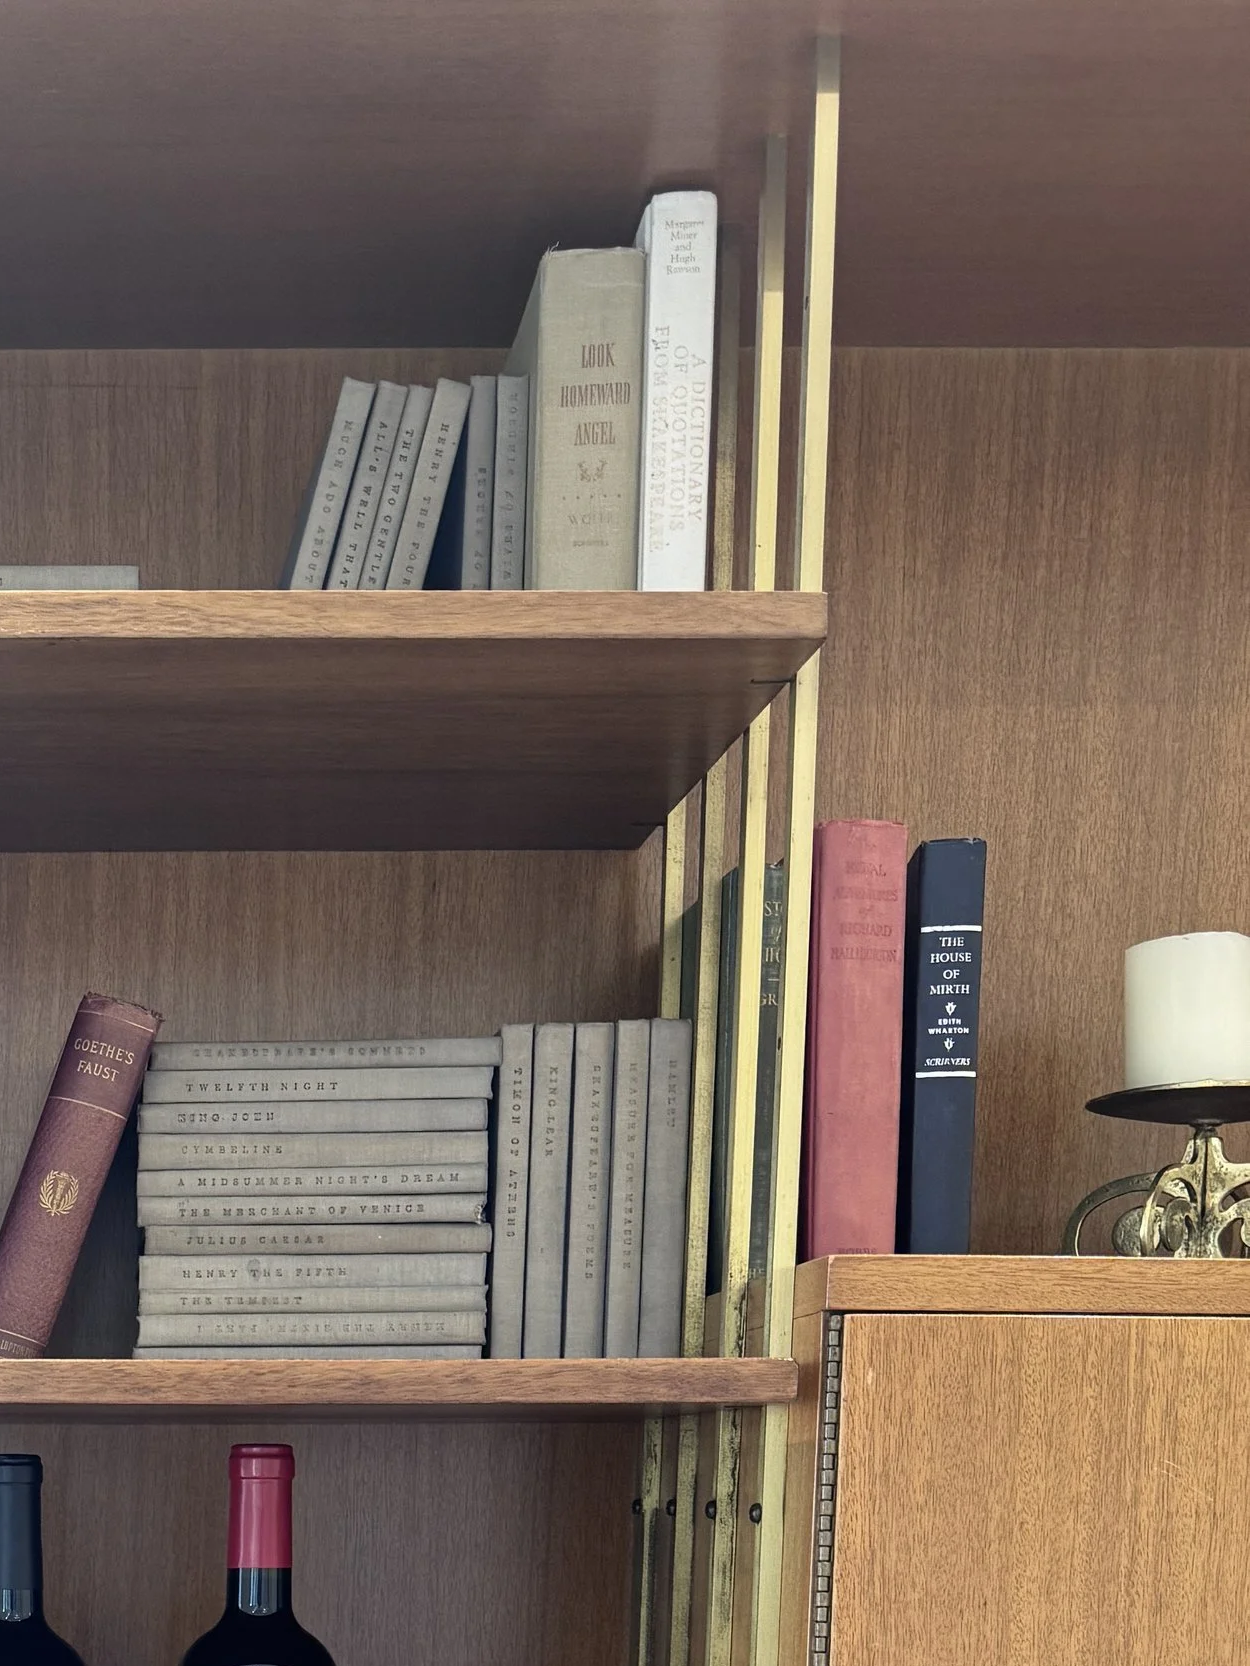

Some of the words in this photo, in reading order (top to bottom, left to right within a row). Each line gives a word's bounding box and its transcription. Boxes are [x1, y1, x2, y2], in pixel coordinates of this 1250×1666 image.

[665, 219, 705, 231] Margaret
[670, 230, 698, 241] Miner
[670, 252, 696, 265] Hugh
[674, 240, 692, 251] and
[666, 264, 701, 275] Rawson
[580, 342, 616, 369] LOOK
[651, 325, 671, 388] FROM
[673, 344, 690, 375] OF
[691, 352, 708, 369] A
[559, 381, 632, 409] HOMEWARD
[333, 419, 355, 469] MUCH
[368, 421, 389, 473] ALL'S
[398, 428, 415, 463] THE
[573, 420, 617, 447] ANGEL
[428, 422, 451, 484] HENRY
[668, 384, 689, 533] QUOTATIONS
[687, 380, 707, 522] DICTIONARY
[322, 479, 340, 515] ADO
[387, 471, 405, 507] TWO
[353, 485, 373, 531] WELL
[415, 495, 433, 530] THE
[304, 525, 327, 585] ABOUT
[368, 514, 393, 585] GENTLE
[339, 543, 359, 589] THAT
[401, 541, 421, 587] FOUR
[939, 936, 965, 948] THE
[930, 952, 972, 964] HOUSE
[942, 969, 961, 980] OF
[930, 984, 971, 996] MIRTH
[928, 1027, 970, 1036] WHARTON
[937, 1018, 962, 1026] EDITH
[73, 1037, 136, 1066] GOETHE'S
[76, 1059, 121, 1082] FAUST
[185, 1082, 269, 1093] TWELFTH
[280, 1082, 339, 1092] NIGHT
[511, 1066, 524, 1125] TIMON
[547, 1065, 560, 1109] KING
[180, 1145, 284, 1155] CYMBELINE
[510, 1137, 521, 1158] OF
[545, 1115, 556, 1158] LEAR
[177, 1177, 186, 1187] A
[197, 1177, 304, 1188] MIDSUMMER
[315, 1175, 390, 1186] NIGHT'S
[400, 1173, 461, 1184] DREAM
[178, 1207, 212, 1218] THE
[222, 1206, 318, 1218] MERCHANT
[327, 1205, 349, 1216] OF
[359, 1203, 426, 1215] VENICE
[505, 1169, 520, 1239] ATHENS
[186, 1235, 248, 1247] JULIUS
[258, 1234, 326, 1245] CAESAR
[182, 1269, 239, 1280] HENRY
[250, 1268, 285, 1278] THE
[295, 1266, 348, 1278] FIFTH
[180, 1297, 214, 1306] THE
[223, 1296, 304, 1306] TEMPEST
